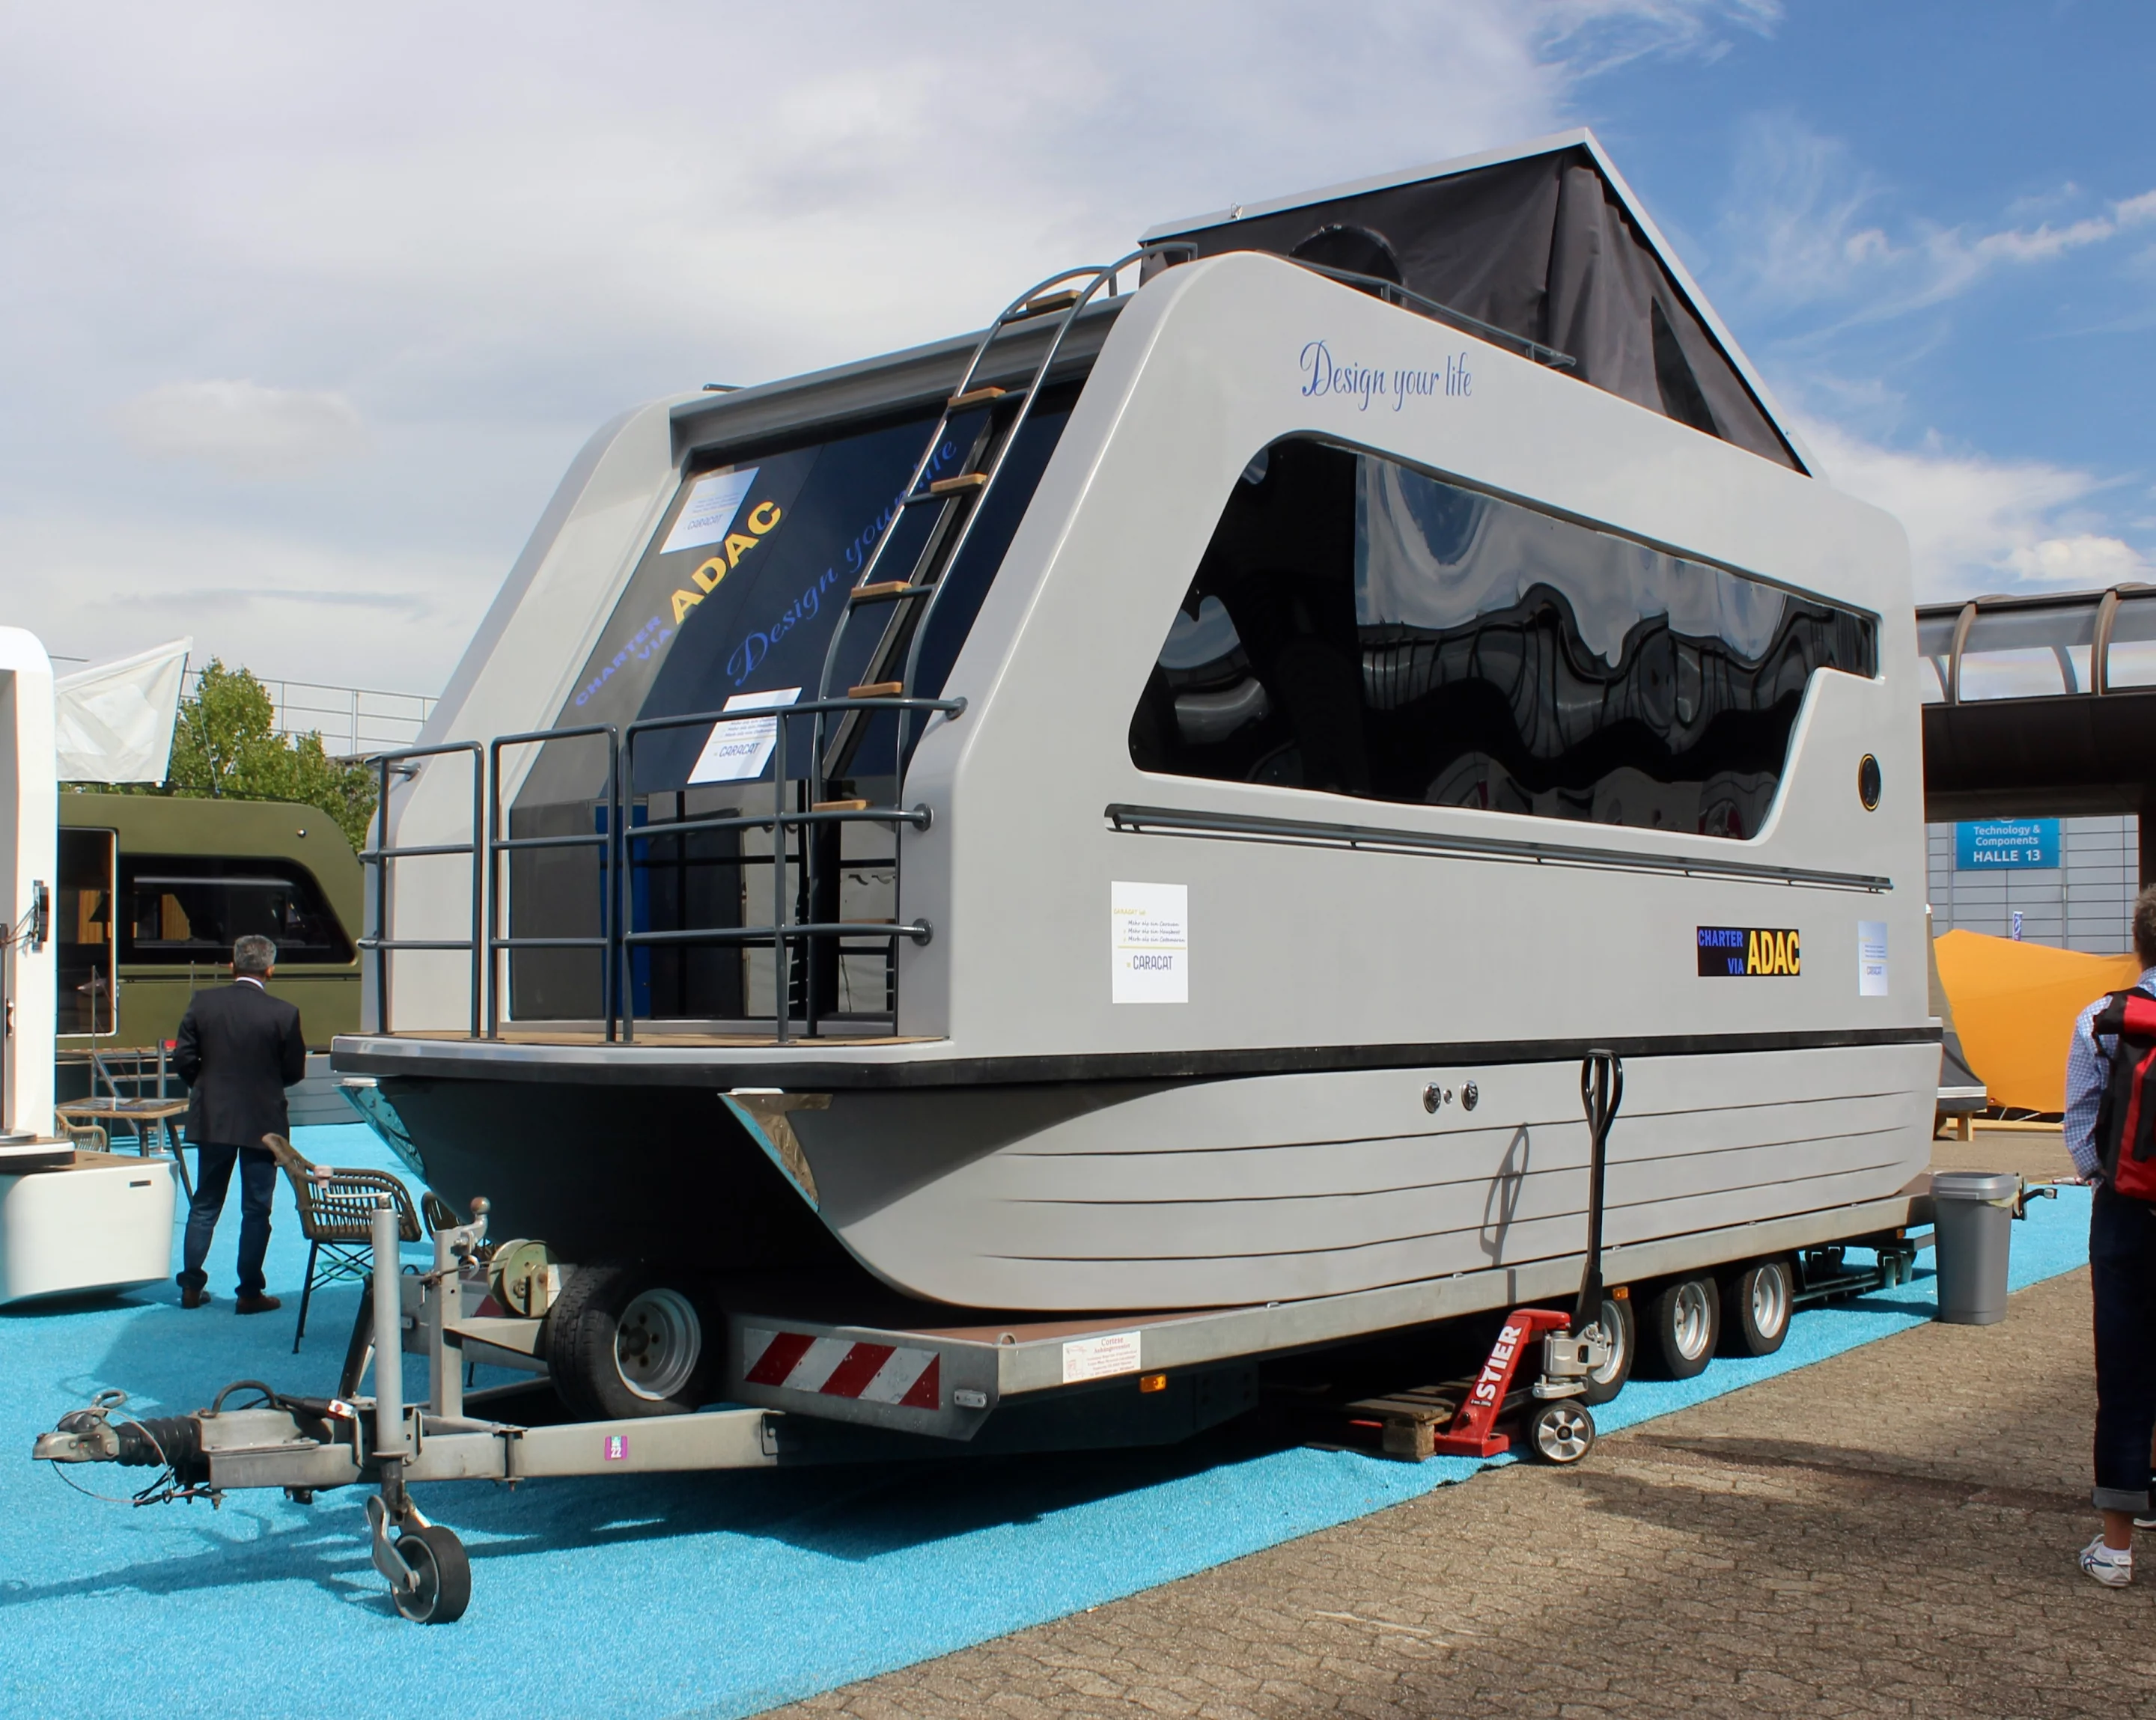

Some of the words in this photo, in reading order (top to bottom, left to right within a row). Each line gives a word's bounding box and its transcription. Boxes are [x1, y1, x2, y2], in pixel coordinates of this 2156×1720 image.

[1300, 339, 1386, 412] Design
[1392, 369, 1440, 412] your
[1446, 351, 1473, 397] life
[671, 500, 782, 625] ADAC
[726, 567, 838, 686] Design
[637, 628, 673, 660] VIA
[575, 615, 662, 706] CHARTER
[719, 742, 761, 757] CARACAT
[1973, 826, 2029, 835] Technology
[2032, 824, 2041, 834] &
[1976, 836, 2038, 847] Components
[1973, 850, 2018, 862] HALLE
[2026, 850, 2041, 861] 13
[1698, 929, 1744, 948] CHARTER
[1747, 930, 1800, 975] ADAC
[1133, 955, 1173, 971] CARACAT
[1727, 957, 1745, 975] VIA
[1476, 1325, 1522, 1400] STIER
[610, 1447, 622, 1459] 22
